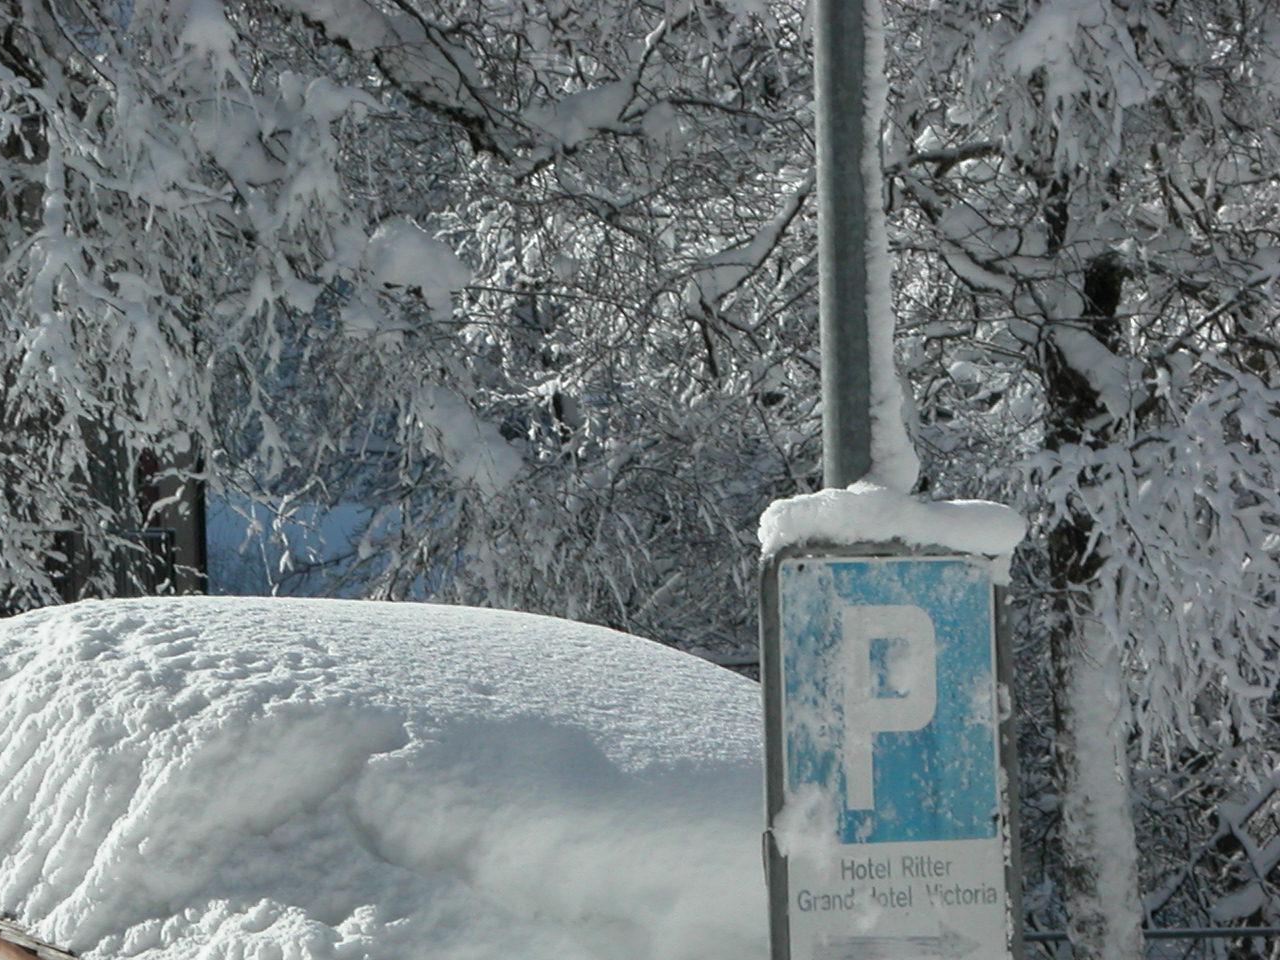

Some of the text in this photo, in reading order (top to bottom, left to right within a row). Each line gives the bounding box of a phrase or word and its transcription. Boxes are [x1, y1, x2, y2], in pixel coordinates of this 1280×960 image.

[842, 604, 937, 810] P
[841, 855, 953, 880] Hotel Ritter
[797, 888, 856, 912] Grand
